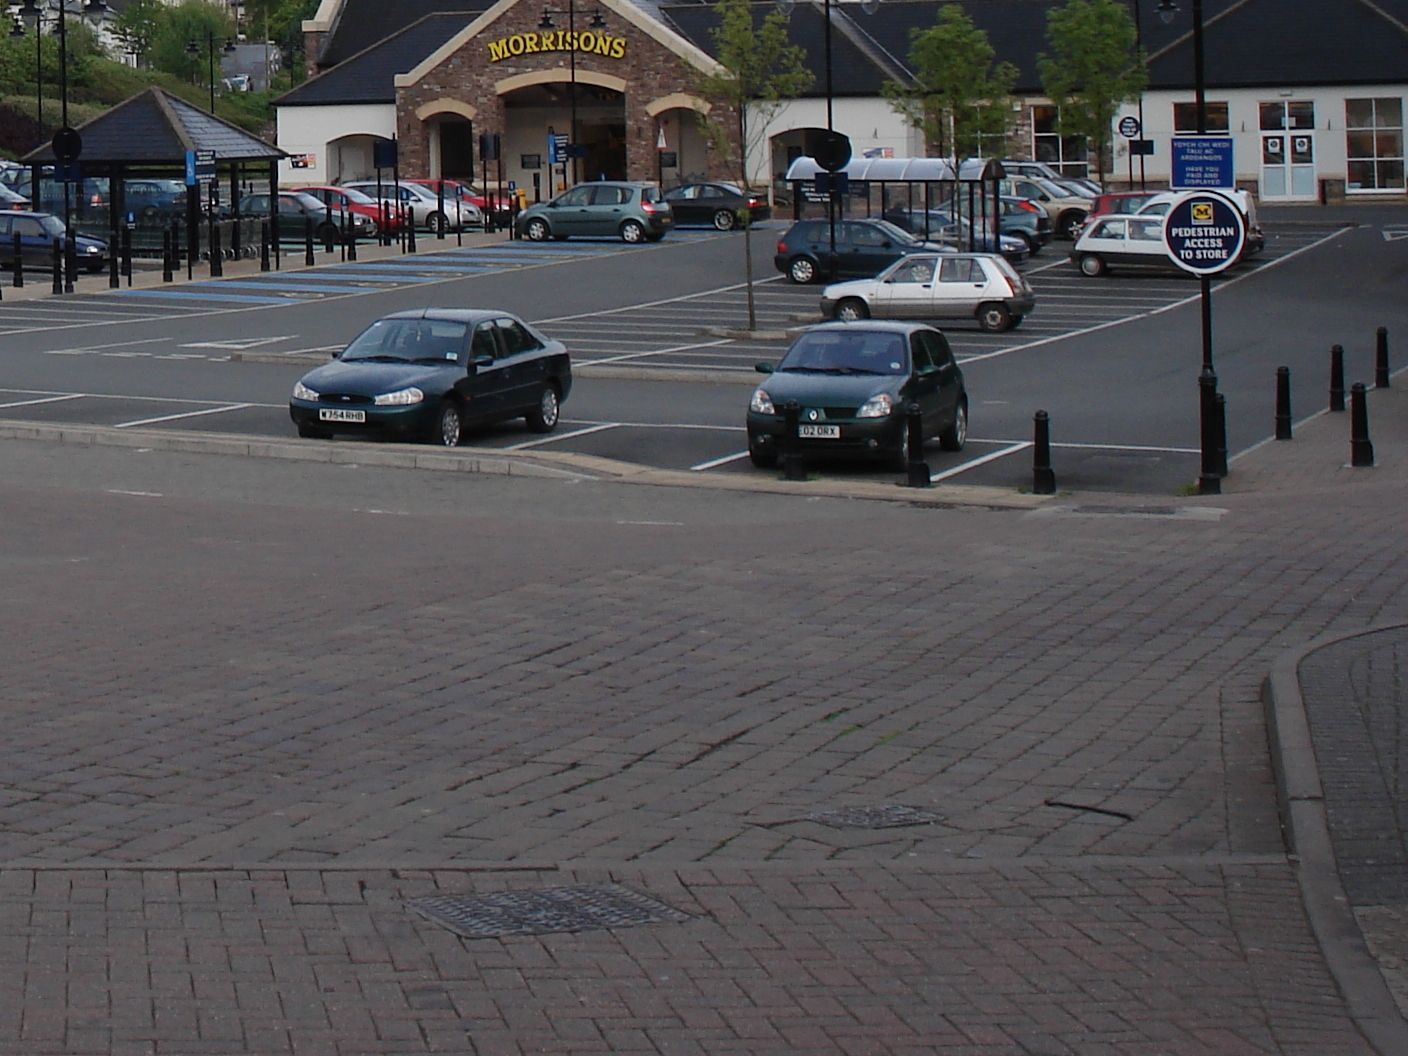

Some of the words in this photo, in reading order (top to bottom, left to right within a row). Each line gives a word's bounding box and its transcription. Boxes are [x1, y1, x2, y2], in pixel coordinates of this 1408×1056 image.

[488, 31, 627, 62] MORRISONS
[1172, 227, 1234, 237] PEDESTRIAN
[1184, 238, 1223, 248] ACCESS
[1180, 250, 1193, 259] TO
[1196, 249, 1228, 259] STORE
